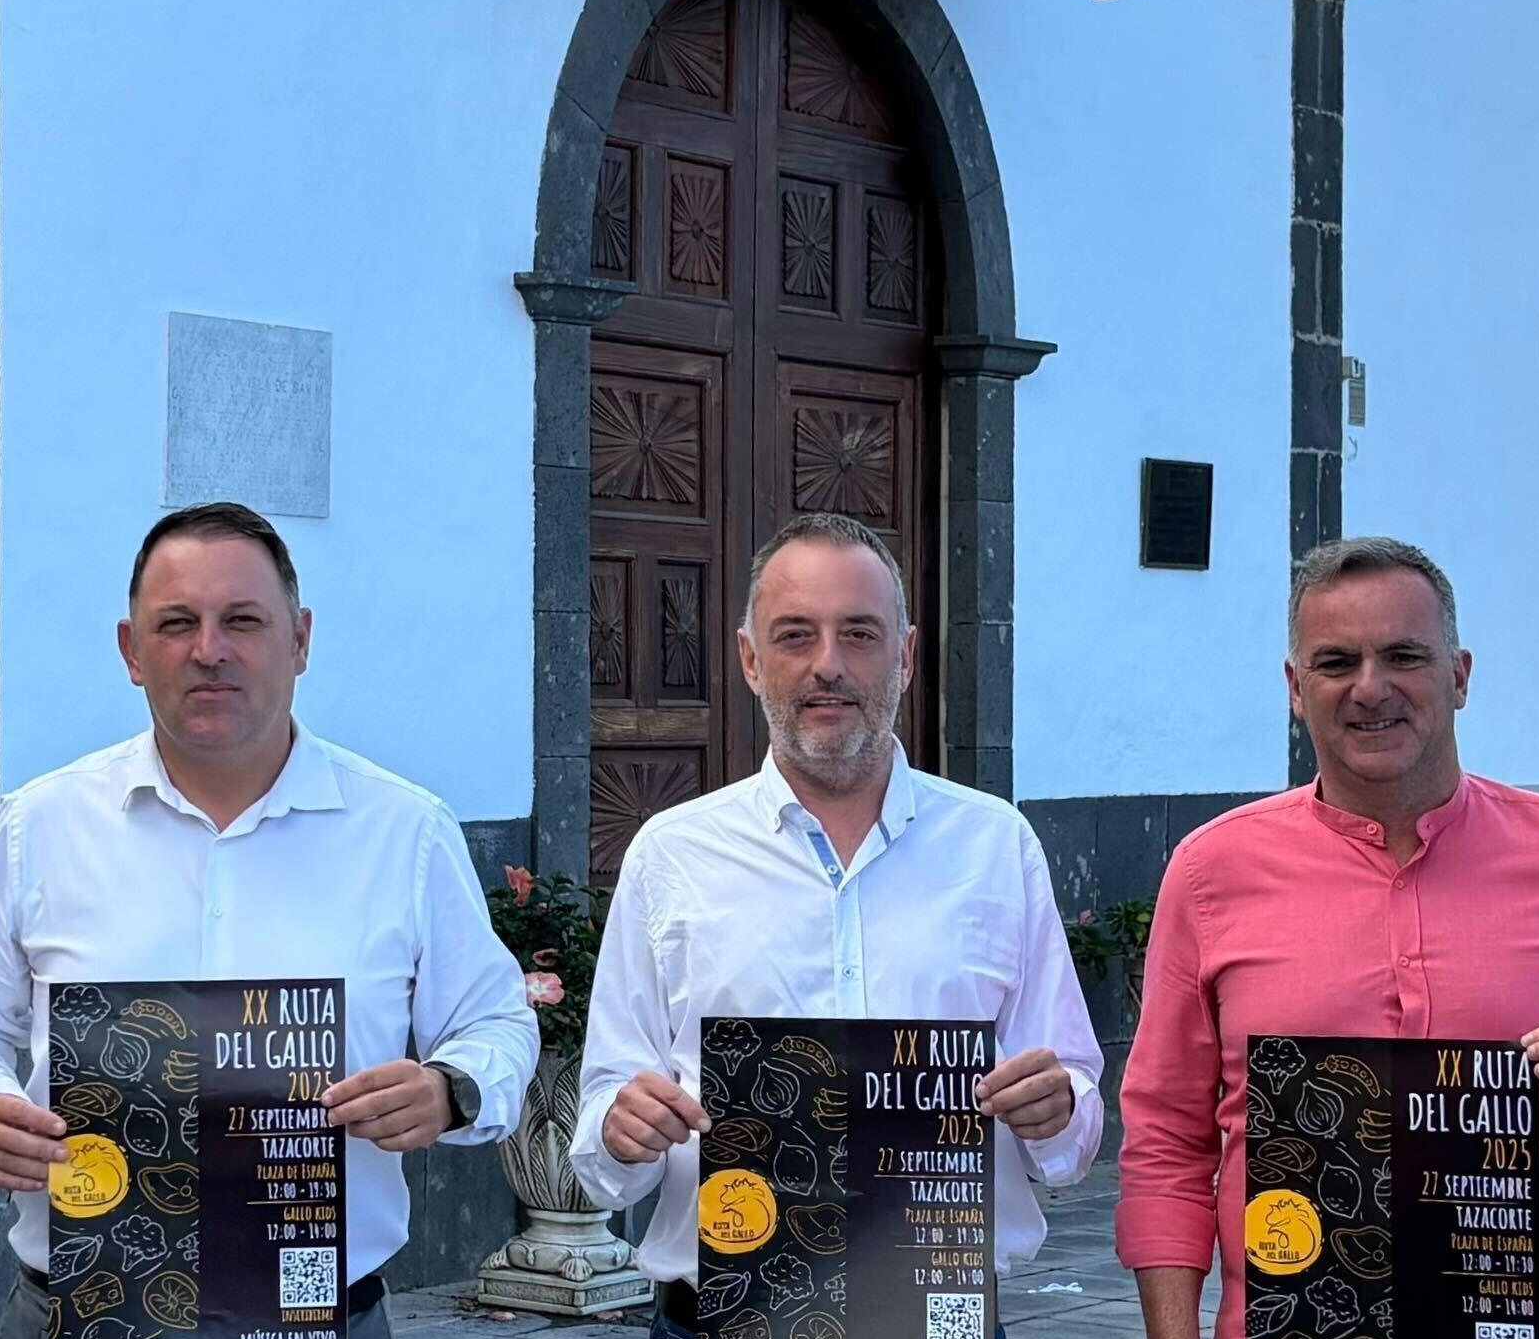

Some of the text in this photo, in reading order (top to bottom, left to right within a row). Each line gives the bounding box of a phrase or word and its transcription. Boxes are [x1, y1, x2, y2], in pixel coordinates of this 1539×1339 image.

[243, 988, 336, 1025] XX RUTA
[216, 1030, 336, 1069] DEL GALLO
[893, 1029, 985, 1067] XX RUTA
[1436, 1050, 1530, 1089] XX RUTA
[866, 1072, 983, 1111] DEL GALLO
[228, 1107, 334, 1130] 27 SEPTIEMBR
[1409, 1093, 1532, 1135] DEL GALLO
[937, 1114, 984, 1145] 2025
[262, 1137, 335, 1158] TAZACORTE
[878, 1147, 984, 1173] 27 SEPTIEMBRE
[1482, 1138, 1530, 1170] 2025
[267, 1182, 296, 1199] 12:00
[309, 1182, 336, 1198] 19:30
[910, 1181, 984, 1203] TAZACORTE
[1422, 1171, 1532, 1199] 27 SEPTIEMBRE
[284, 1206, 336, 1221] GALLO KIDS
[1456, 1206, 1532, 1230] TAZACORTE
[1462, 1253, 1492, 1271] 12:00
[1505, 1255, 1534, 1273] 19:30
[1479, 1280, 1533, 1296] GALLO KIDS
